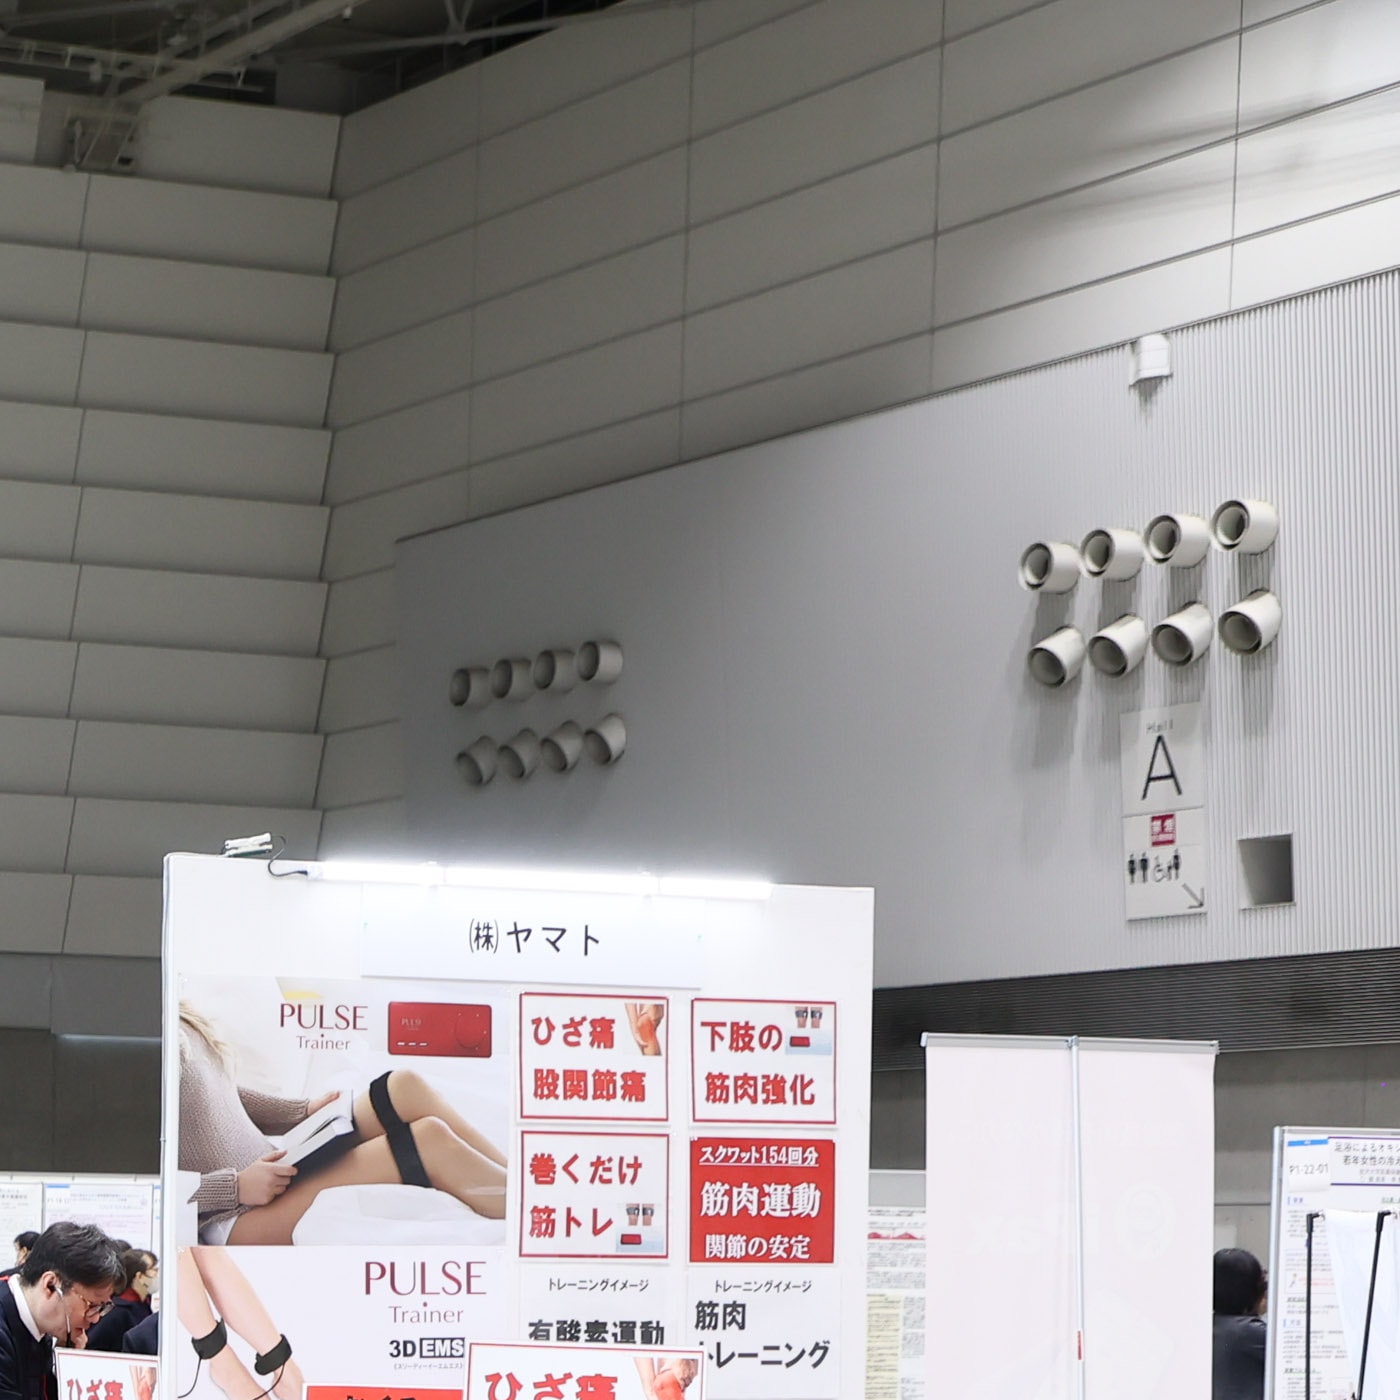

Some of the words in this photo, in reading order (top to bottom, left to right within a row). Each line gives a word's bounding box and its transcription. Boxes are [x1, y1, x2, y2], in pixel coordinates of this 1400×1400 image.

[1142, 735, 1182, 800] A
[279, 1003, 369, 1033] PULSE
[530, 1015, 616, 1048] ひざ痛
[296, 1033, 351, 1051] Trainer
[700, 1019, 784, 1055] 下肢の
[532, 1068, 647, 1104] 股関節痛
[703, 1072, 816, 1107] 筋肉強化
[528, 1152, 642, 1186] 巻くだけ
[699, 1144, 820, 1168] スクワット154回分
[700, 1182, 821, 1220] 筋肉運動
[528, 1205, 615, 1240] 筋トレ
[703, 1234, 811, 1261] 関節の安定
[364, 1260, 487, 1296] PULSE
[547, 1277, 650, 1294] トレーニングイメージ
[713, 1278, 813, 1294] トレーニングイメージ
[388, 1301, 464, 1324] Trainer
[695, 1299, 747, 1331] 筋肉
[527, 1318, 666, 1346] 有酸素運動
